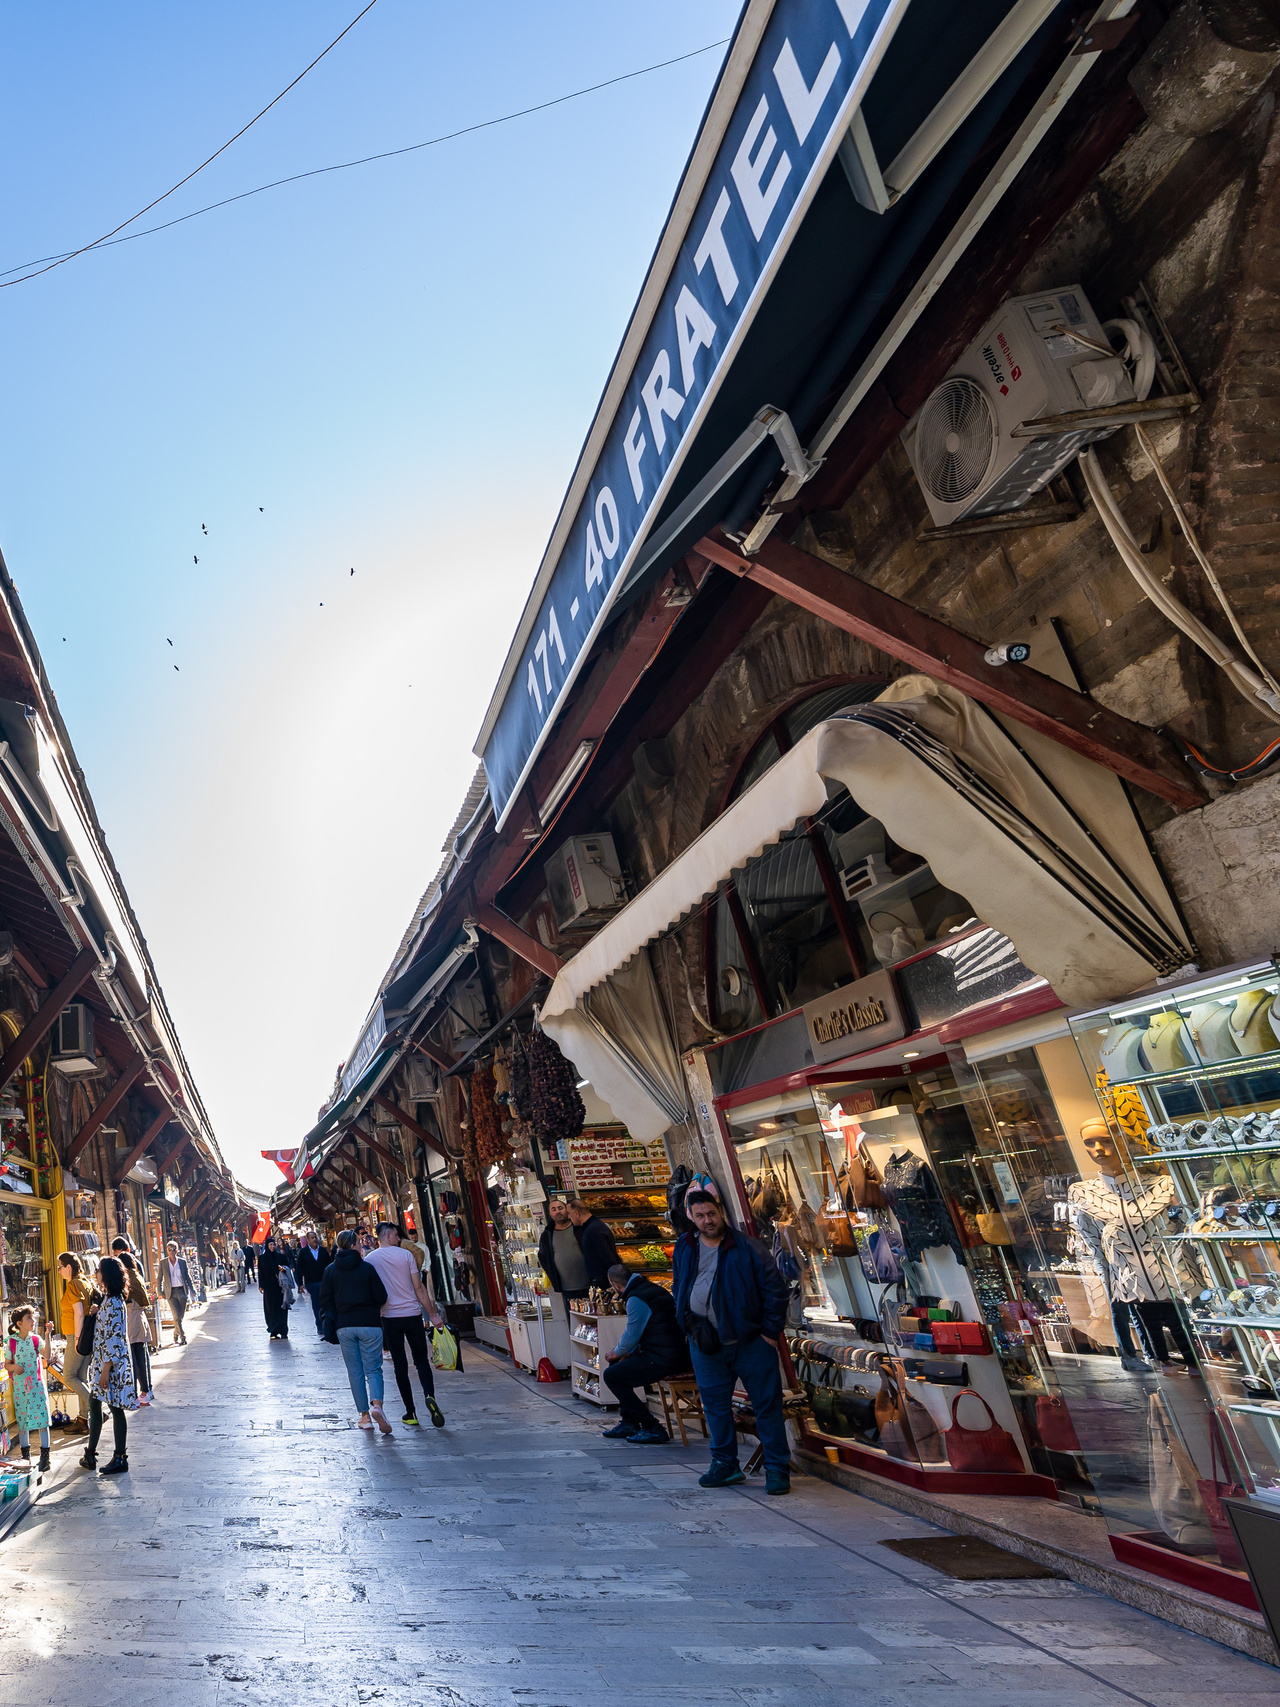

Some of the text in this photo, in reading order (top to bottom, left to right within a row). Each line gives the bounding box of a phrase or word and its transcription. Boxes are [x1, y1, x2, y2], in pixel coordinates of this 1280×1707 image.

[982, 344, 1005, 383] arçelik
[527, 606, 566, 714] 171
[585, 486, 620, 593] 40
[812, 997, 885, 1043] Charlie's Classics
